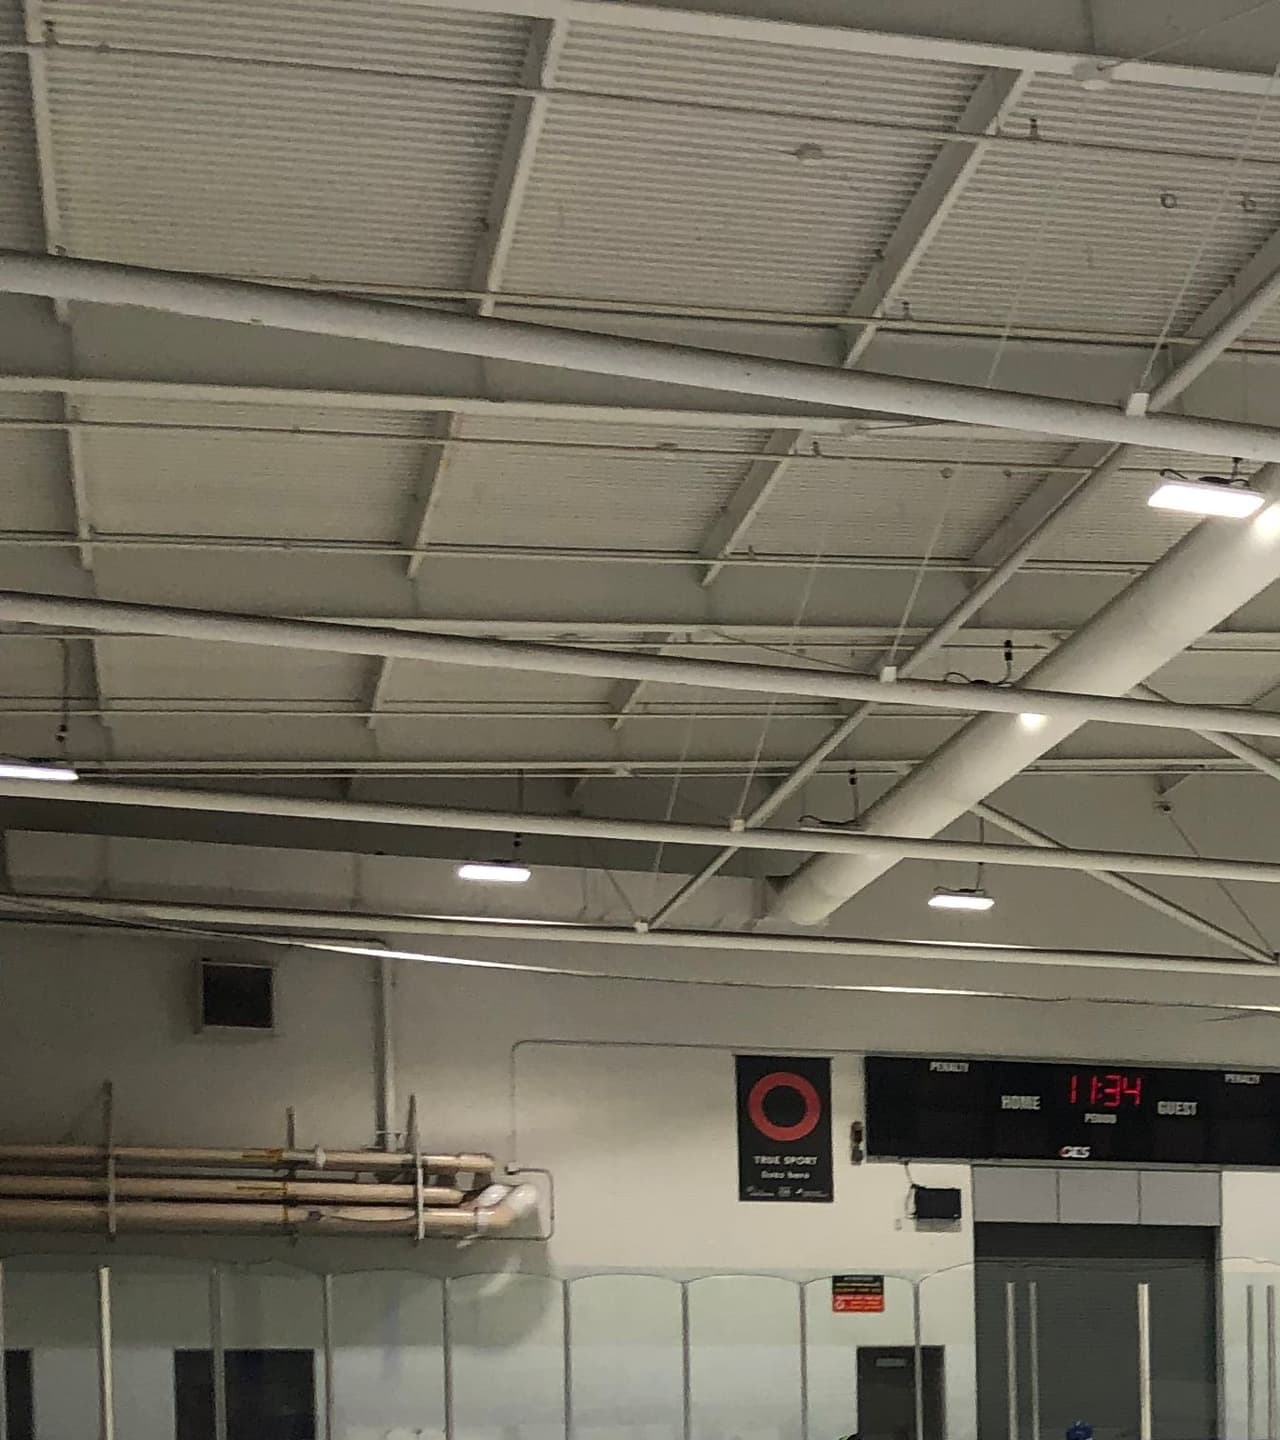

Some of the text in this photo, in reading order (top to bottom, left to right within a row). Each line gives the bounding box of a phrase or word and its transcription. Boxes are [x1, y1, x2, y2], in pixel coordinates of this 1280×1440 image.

[1070, 1075, 1142, 1107] 11:34
[1001, 1095, 1040, 1110] HOME
[1157, 1101, 1197, 1116] GUEST
